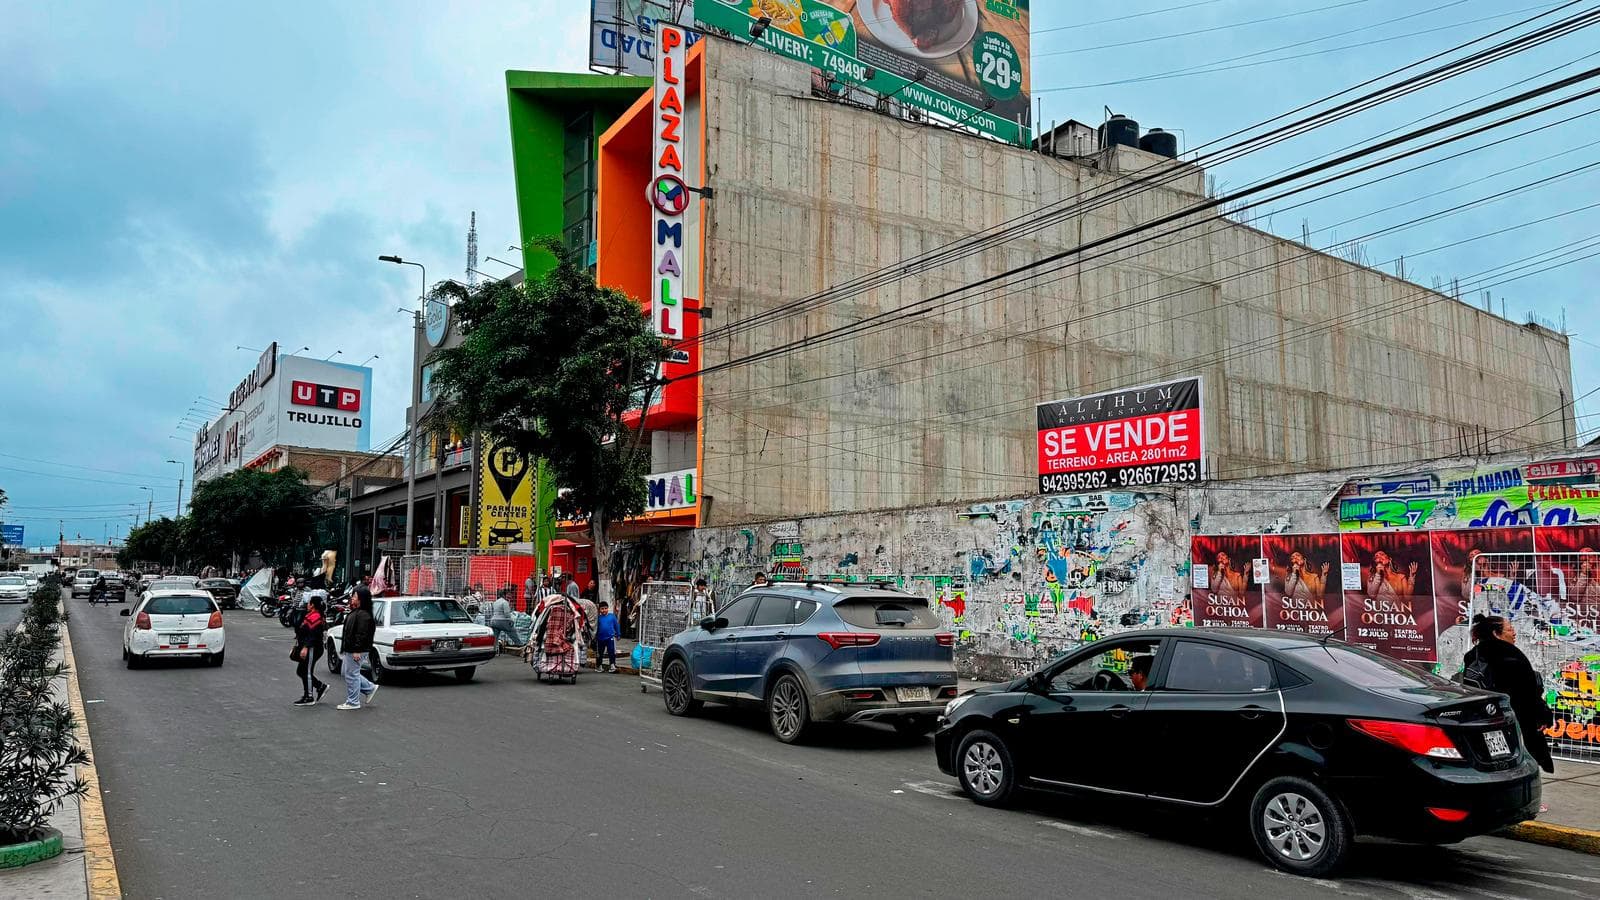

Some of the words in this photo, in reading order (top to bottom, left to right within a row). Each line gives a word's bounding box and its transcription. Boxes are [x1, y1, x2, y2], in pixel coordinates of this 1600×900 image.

[659, 27, 682, 172] PLAZA
[902, 84, 996, 132] www.rokys.com
[658, 219, 682, 335] MALL
[297, 384, 356, 406] UTP
[1058, 388, 1173, 417] ALTHUM
[287, 411, 362, 428] TRUJILLO
[1058, 413, 1096, 424] REAL
[1108, 401, 1173, 417] ESTATE
[1045, 429, 1077, 457] SE
[1085, 413, 1189, 452] VENDE
[1047, 455, 1097, 470] TERRENO
[1106, 451, 1138, 465] AREA
[1141, 445, 1187, 462] 2801m2
[1042, 470, 1107, 493] 942995262
[1119, 462, 1197, 486] 926672953
[486, 504, 527, 512] PARKING
[1207, 592, 1246, 606] SUSAN
[1281, 596, 1325, 609] SUSAN
[1364, 598, 1413, 613] SUSAN
[1205, 605, 1249, 618] OCHOA
[1279, 609, 1328, 622] OCHOA
[1361, 612, 1418, 626] OCHOA
[1357, 628, 1369, 637] 12
